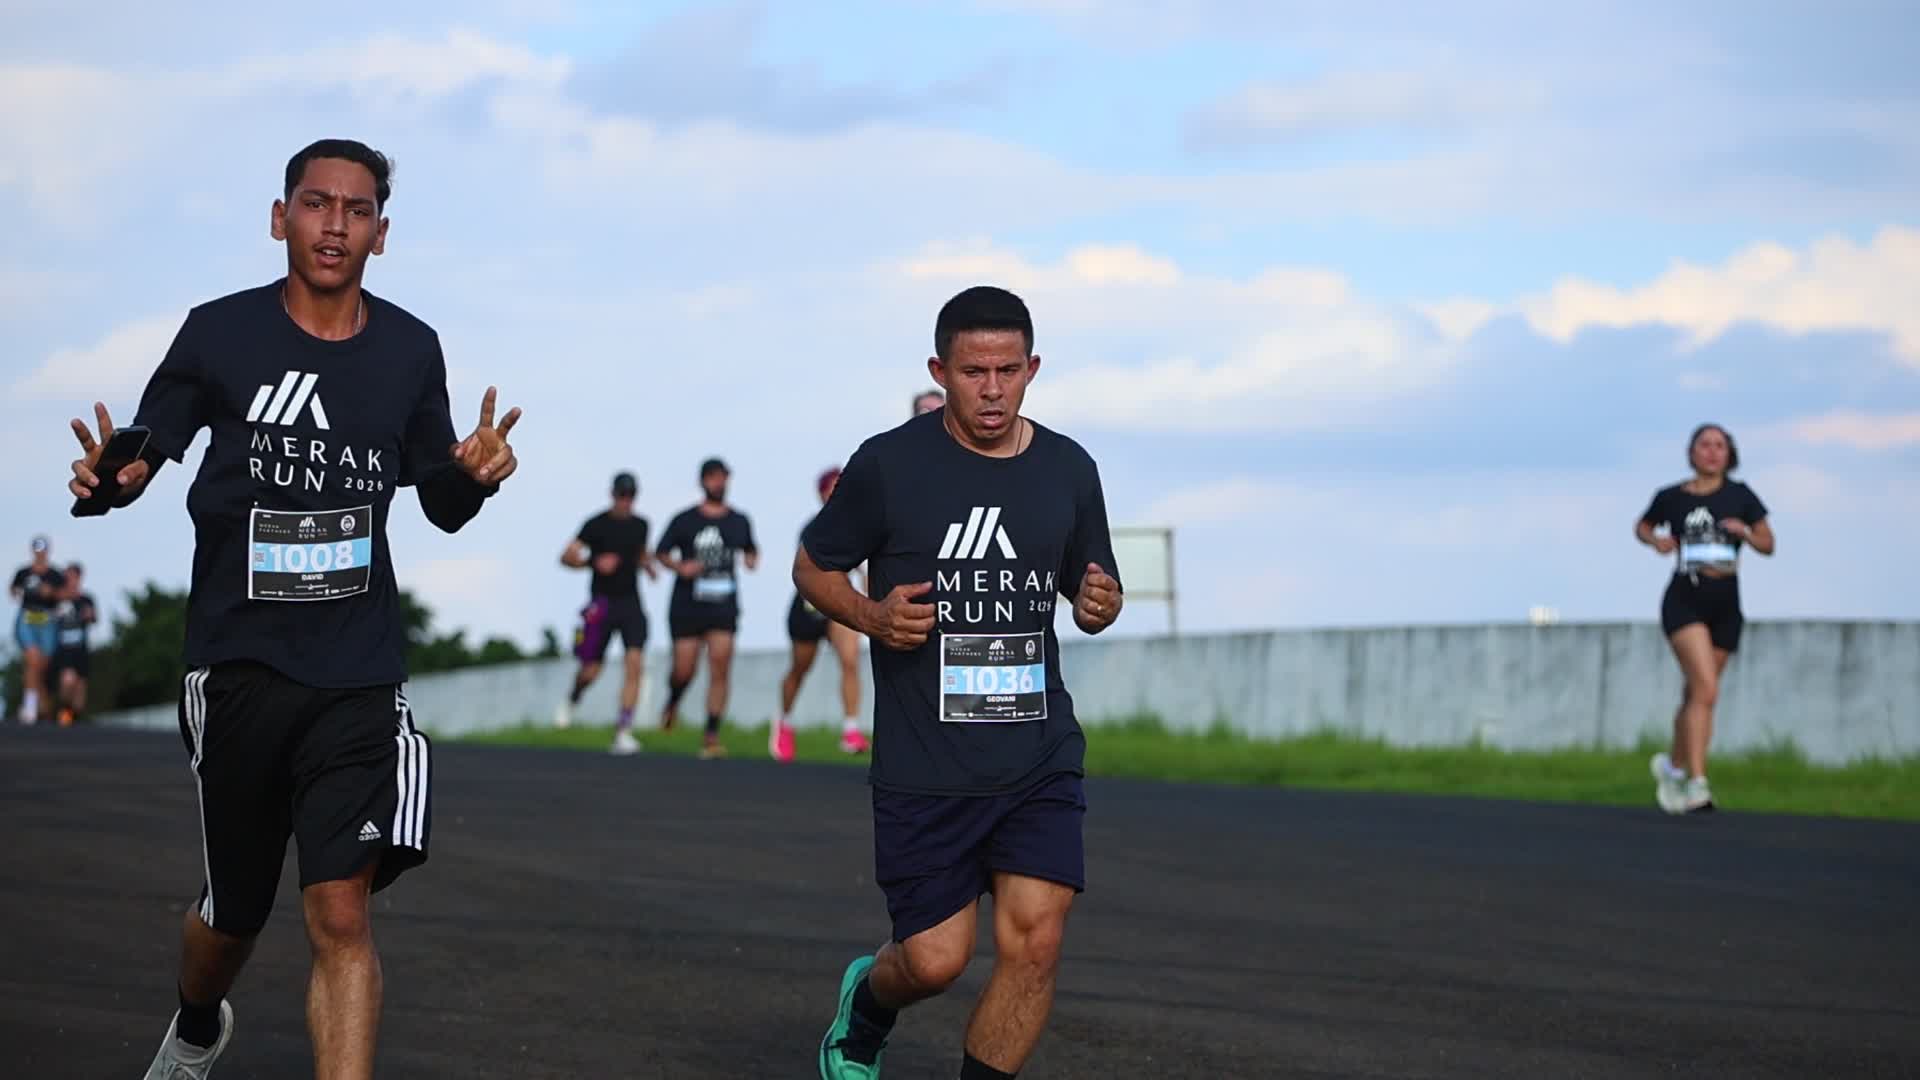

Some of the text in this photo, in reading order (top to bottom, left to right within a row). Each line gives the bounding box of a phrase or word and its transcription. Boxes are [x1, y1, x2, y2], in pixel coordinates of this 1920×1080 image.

[251, 429, 382, 472] MERAK
[249, 457, 384, 492] RUN 2026
[269, 541, 354, 573] 1008
[937, 569, 1056, 592] MERAK
[938, 600, 1013, 623] RUN
[962, 666, 1034, 694] 1036
[986, 695, 1016, 703] GEOVANI
